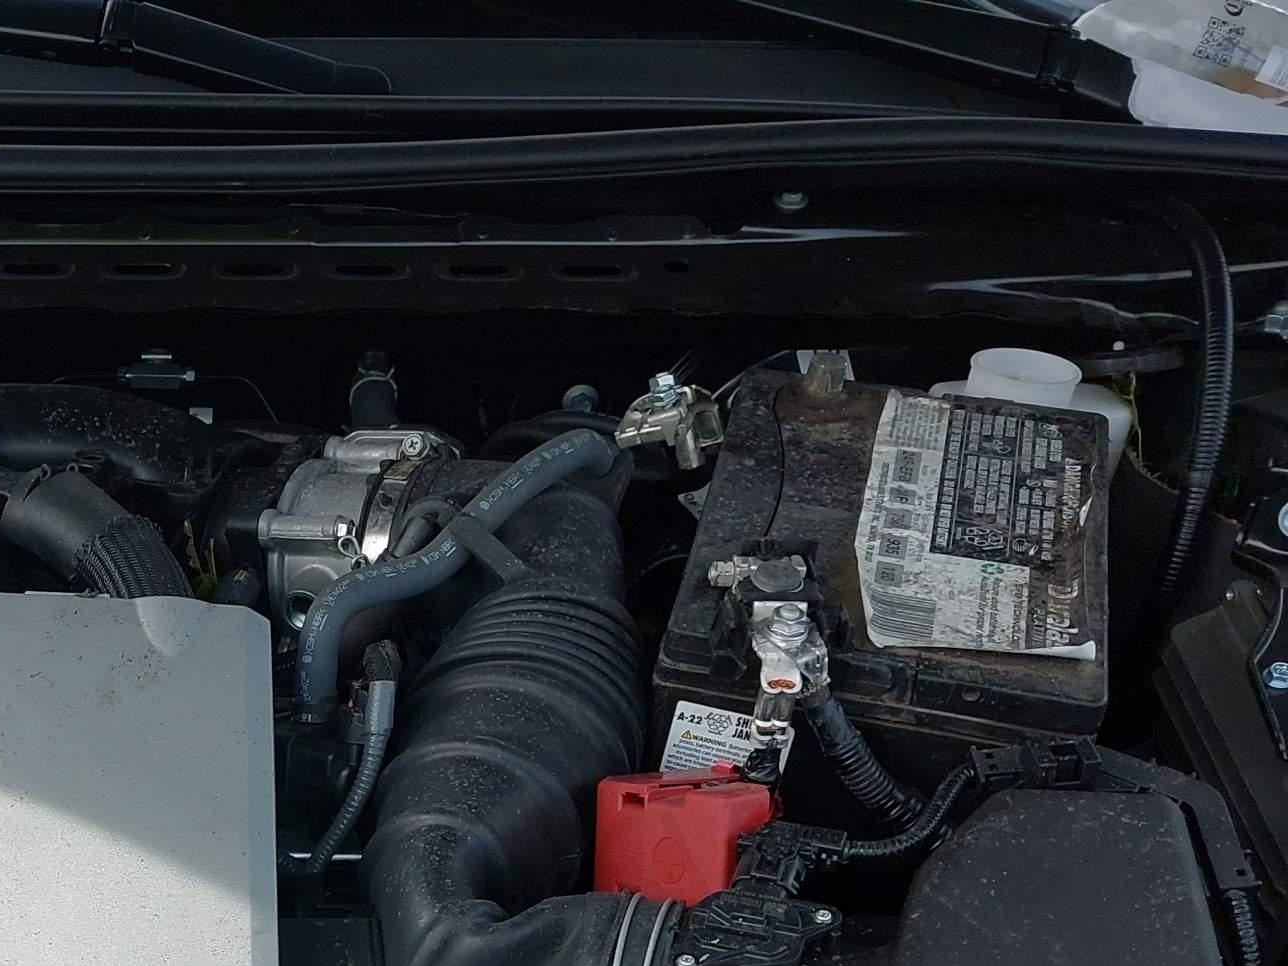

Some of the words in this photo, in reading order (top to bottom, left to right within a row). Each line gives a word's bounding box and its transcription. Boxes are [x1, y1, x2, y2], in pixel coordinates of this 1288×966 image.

[885, 538, 901, 555] 935
[676, 711, 703, 725] A-22
[692, 735, 726, 748] WARNING
[731, 728, 751, 742] JAN
[695, 743, 715, 752] battery
